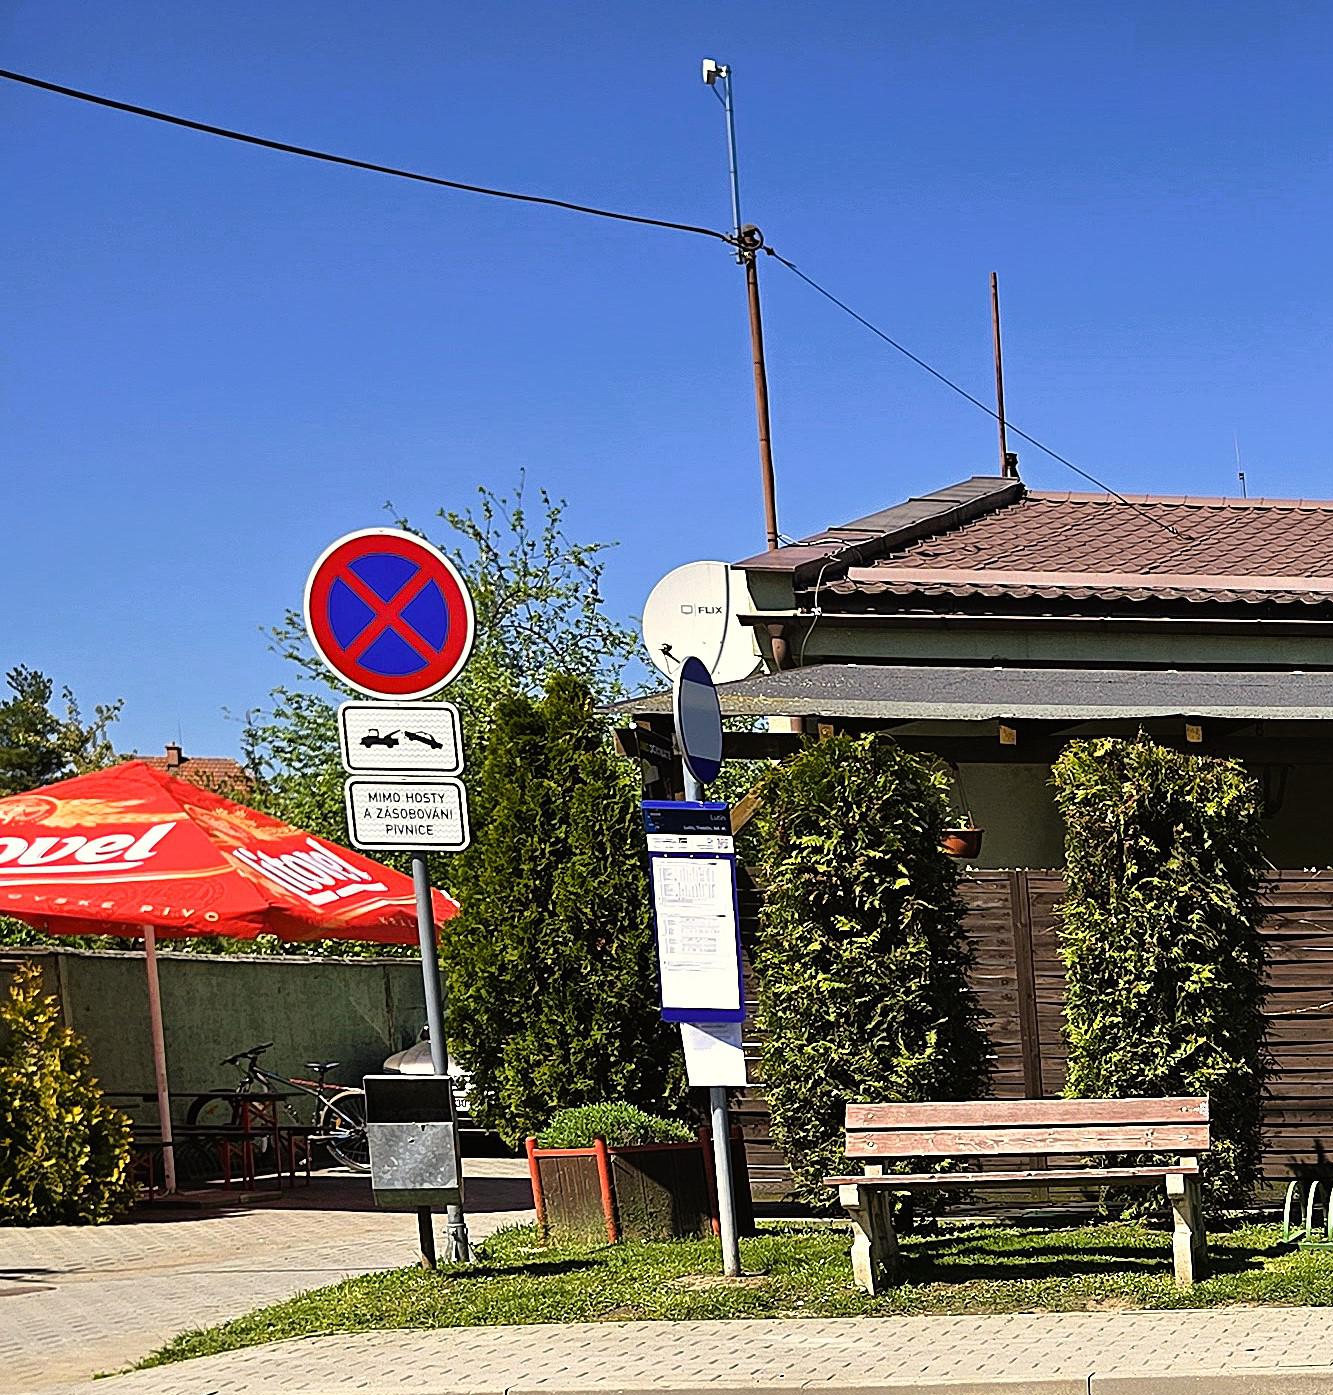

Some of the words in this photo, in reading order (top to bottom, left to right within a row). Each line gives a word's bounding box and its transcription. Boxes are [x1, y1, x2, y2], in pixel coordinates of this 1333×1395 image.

[368, 792, 400, 803] MIMO
[405, 792, 445, 804] HOSTY
[363, 808, 372, 819] A
[385, 824, 434, 836] PIVNICE
[232, 837, 372, 905] Litovel
[139, 904, 219, 922] PIVO
